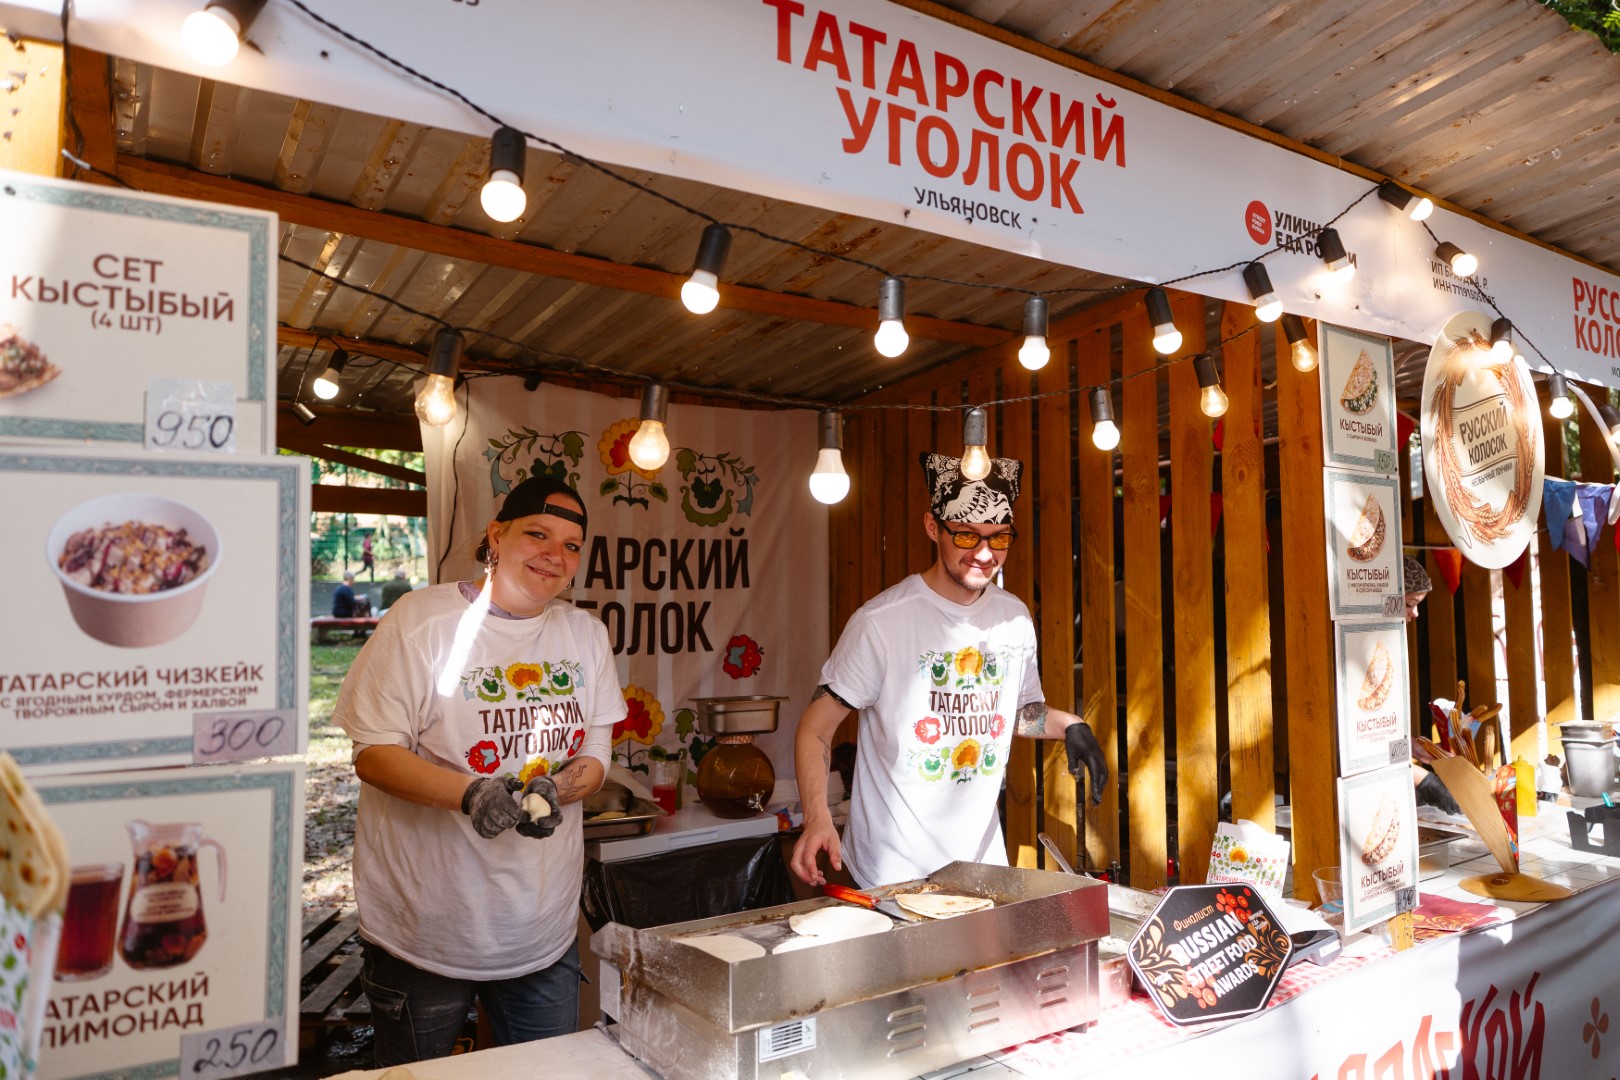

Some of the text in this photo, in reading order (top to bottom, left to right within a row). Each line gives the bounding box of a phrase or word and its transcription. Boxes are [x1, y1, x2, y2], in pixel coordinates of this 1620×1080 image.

[762, 0, 1126, 168] ТАТАРСКИЙ
[835, 86, 1085, 215] УГОЛОК
[914, 187, 1022, 229] УЛЬЯНОВСК
[1274, 210, 1328, 240] УЛИЧН
[92, 253, 163, 284] СЕТ
[10, 274, 235, 322] КЫСТЫБЫЙ
[91, 309, 163, 335] (4 ШТ)
[152, 410, 234, 449] 950
[1339, 417, 1383, 437] КЫСТЫБЫЙ
[1459, 400, 1509, 446] РУССКИЙ
[1468, 432, 1508, 467] КОЛОСОК
[571, 527, 750, 590] АРСКИЙ
[1346, 566, 1389, 581] КЫСТЫБЫЙ
[572, 599, 714, 656] ОЛОК
[0, 661, 264, 693] ТАТАРСКИЙ ЧИЗКЕЙК
[0, 696, 12, 709] С
[16, 693, 92, 708] ЯГОДНЫМ
[164, 685, 259, 700] ФЕРМЕРСКИМ
[14, 696, 248, 720] ТВОРОЖНЫМ СЫРОМ И ХАЛВОЙ
[478, 695, 585, 735] ТАТАРСКИЙ
[200, 716, 285, 756] 300
[1356, 711, 1397, 734] КЫСТЫБЫЙ
[500, 726, 571, 760] УГОЛОК
[1360, 860, 1404, 889] КЫСТЫБЫЙ
[1173, 904, 1215, 932] Финалист
[1185, 950, 1229, 987] STREET
[1226, 934, 1259, 965] FOOD
[1212, 958, 1260, 999] AWARDS
[45, 971, 210, 1021] АТАРСКИЙ
[192, 1028, 279, 1073] 250
